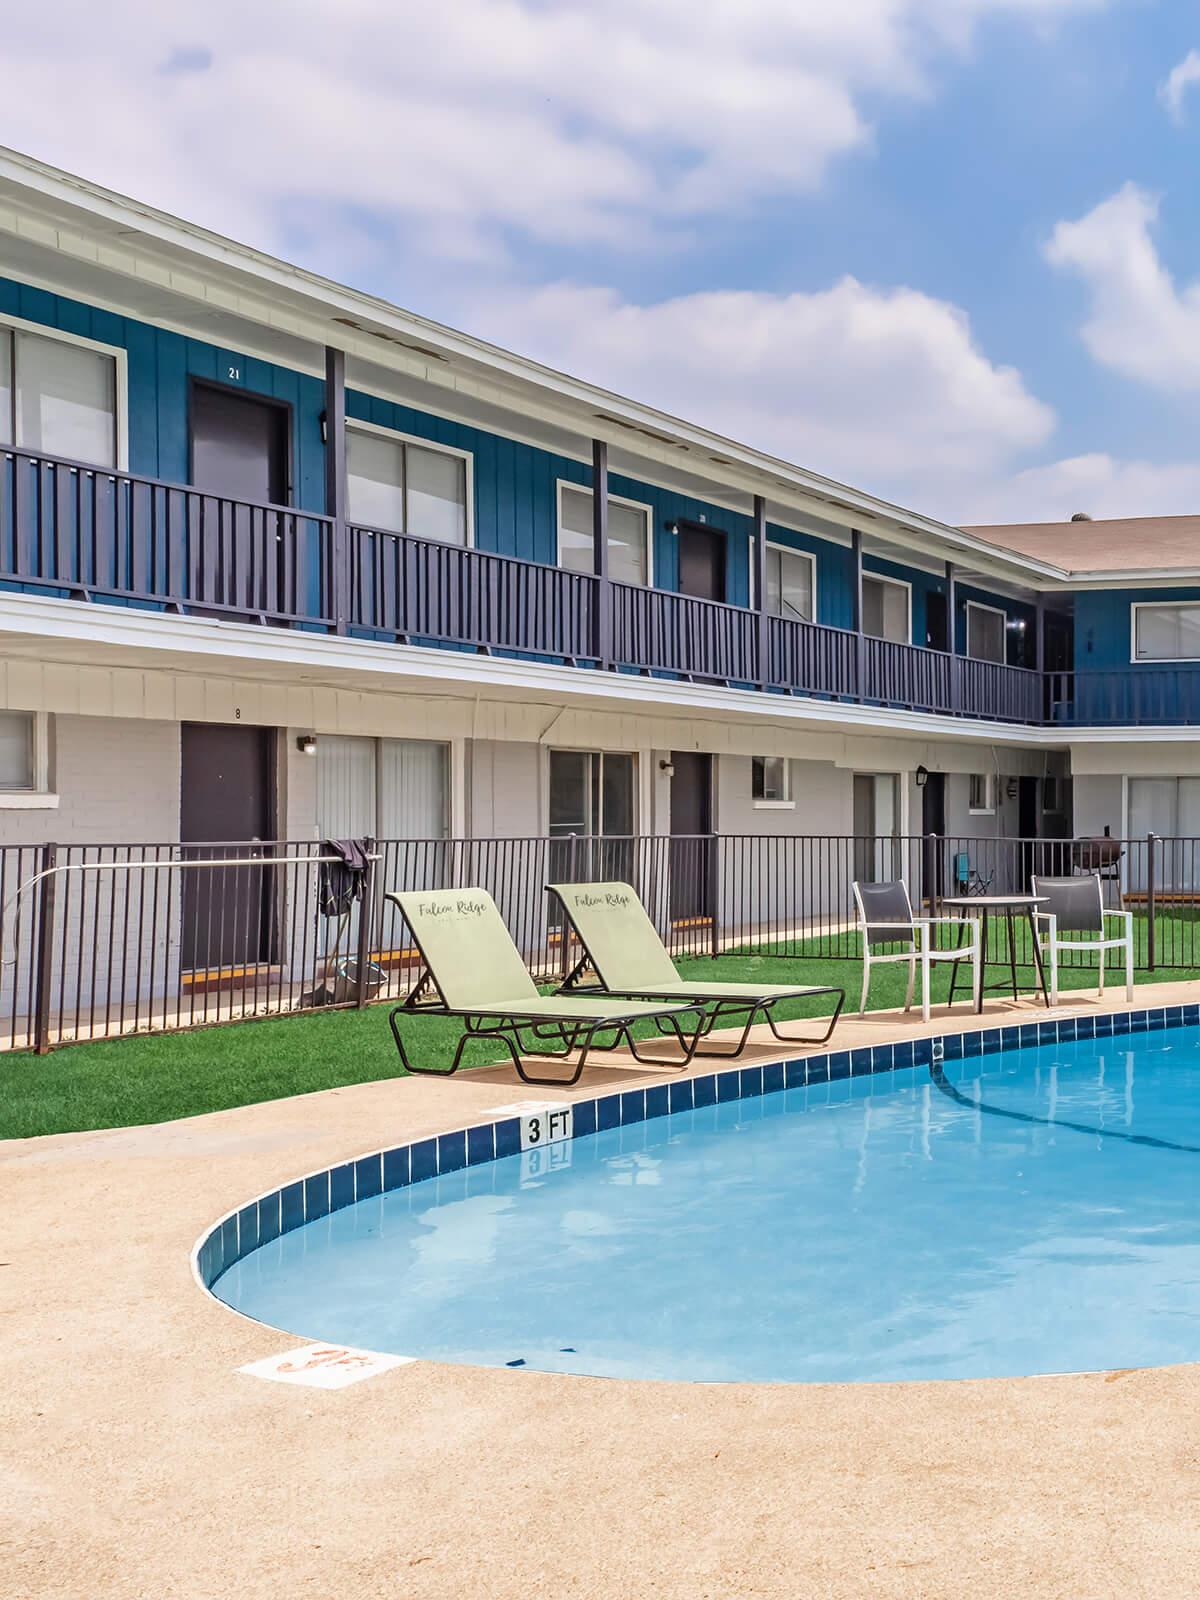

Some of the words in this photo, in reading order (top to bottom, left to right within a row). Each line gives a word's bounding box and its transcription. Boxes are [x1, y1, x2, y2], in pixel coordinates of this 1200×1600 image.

[229, 367, 239, 380] 21
[235, 708, 241, 719] 8
[418, 902, 454, 916] Falcon
[456, 900, 487, 916] Ridge
[574, 894, 603, 907] Falcon
[604, 893, 630, 908] Ridge
[528, 1118, 541, 1144] 3
[550, 1110, 570, 1139] FT
